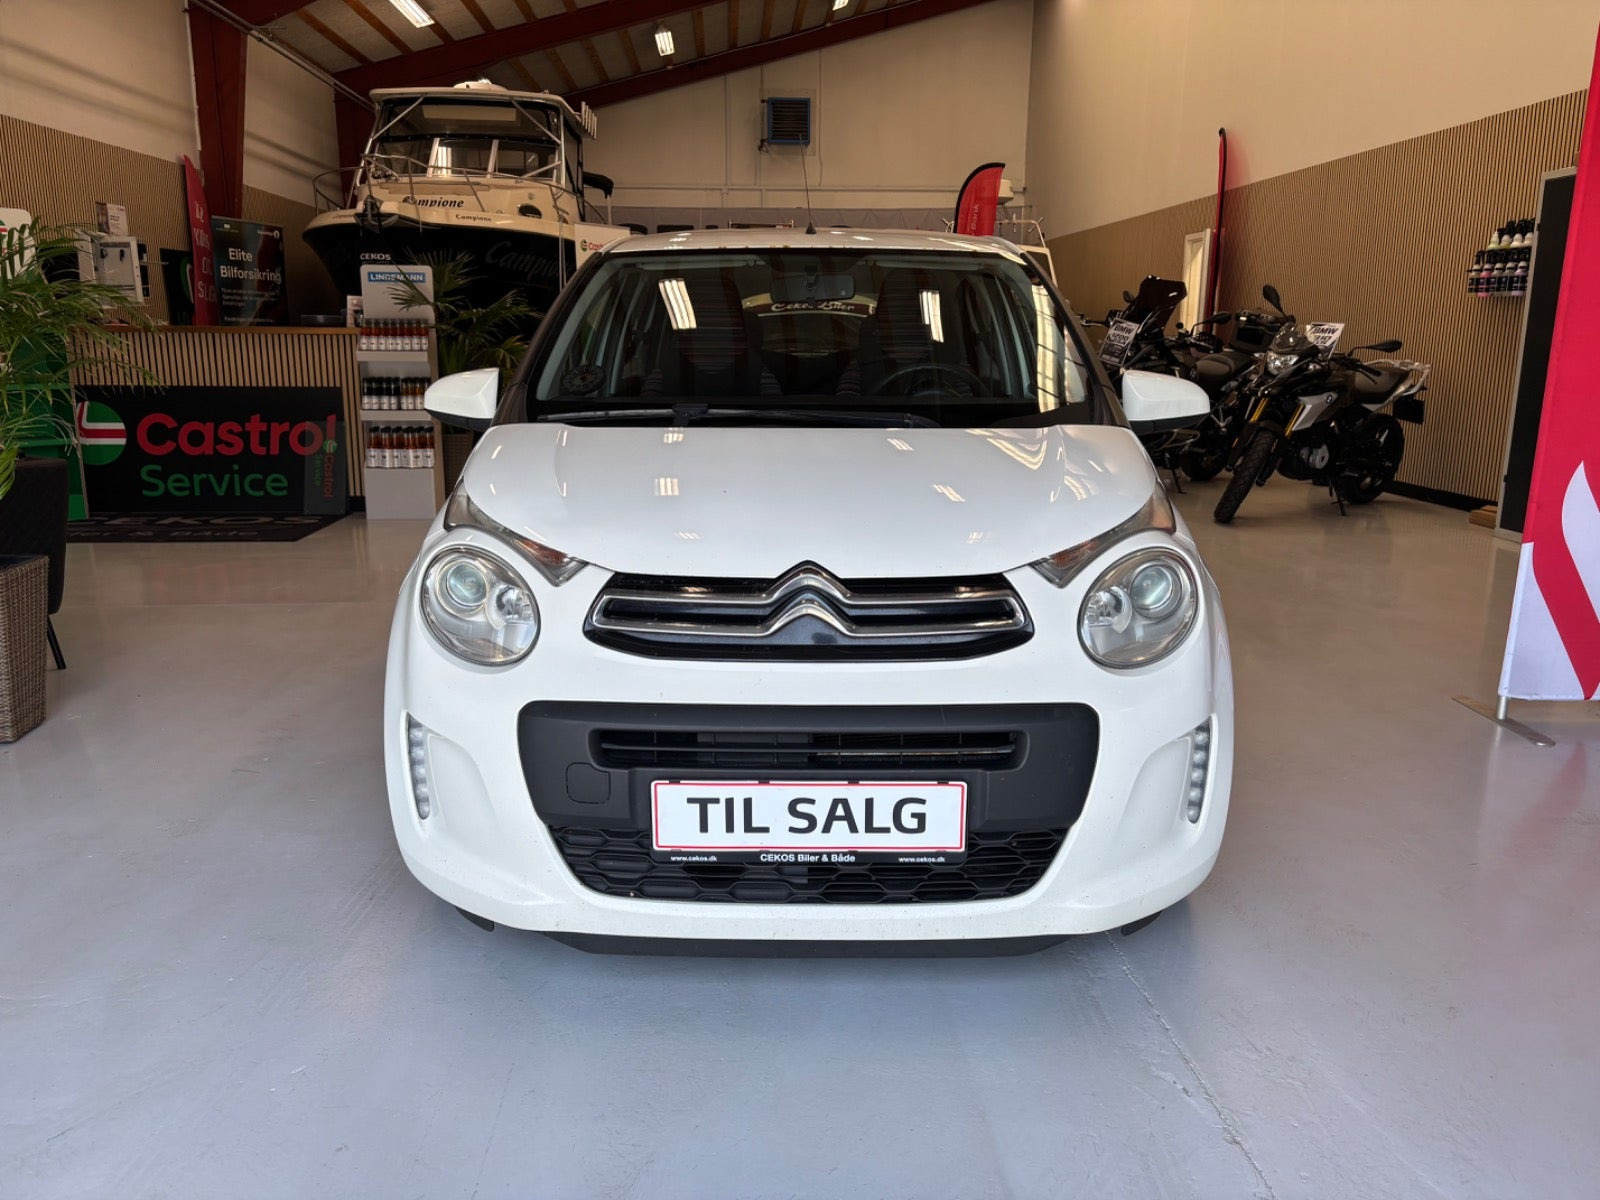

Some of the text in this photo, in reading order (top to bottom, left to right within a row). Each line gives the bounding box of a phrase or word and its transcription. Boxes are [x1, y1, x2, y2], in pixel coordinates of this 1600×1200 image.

[228, 248, 253, 262] Elite
[360, 252, 392, 261] CEKOS
[219, 264, 282, 284] Bilforsikring
[1313, 326, 1339, 335] BMW
[136, 413, 337, 456] Castrol
[141, 464, 288, 497] Service
[323, 453, 335, 499] Castrol
[686, 796, 927, 834] TIL SALG
[760, 853, 856, 862] CEKOS Biler & Både
